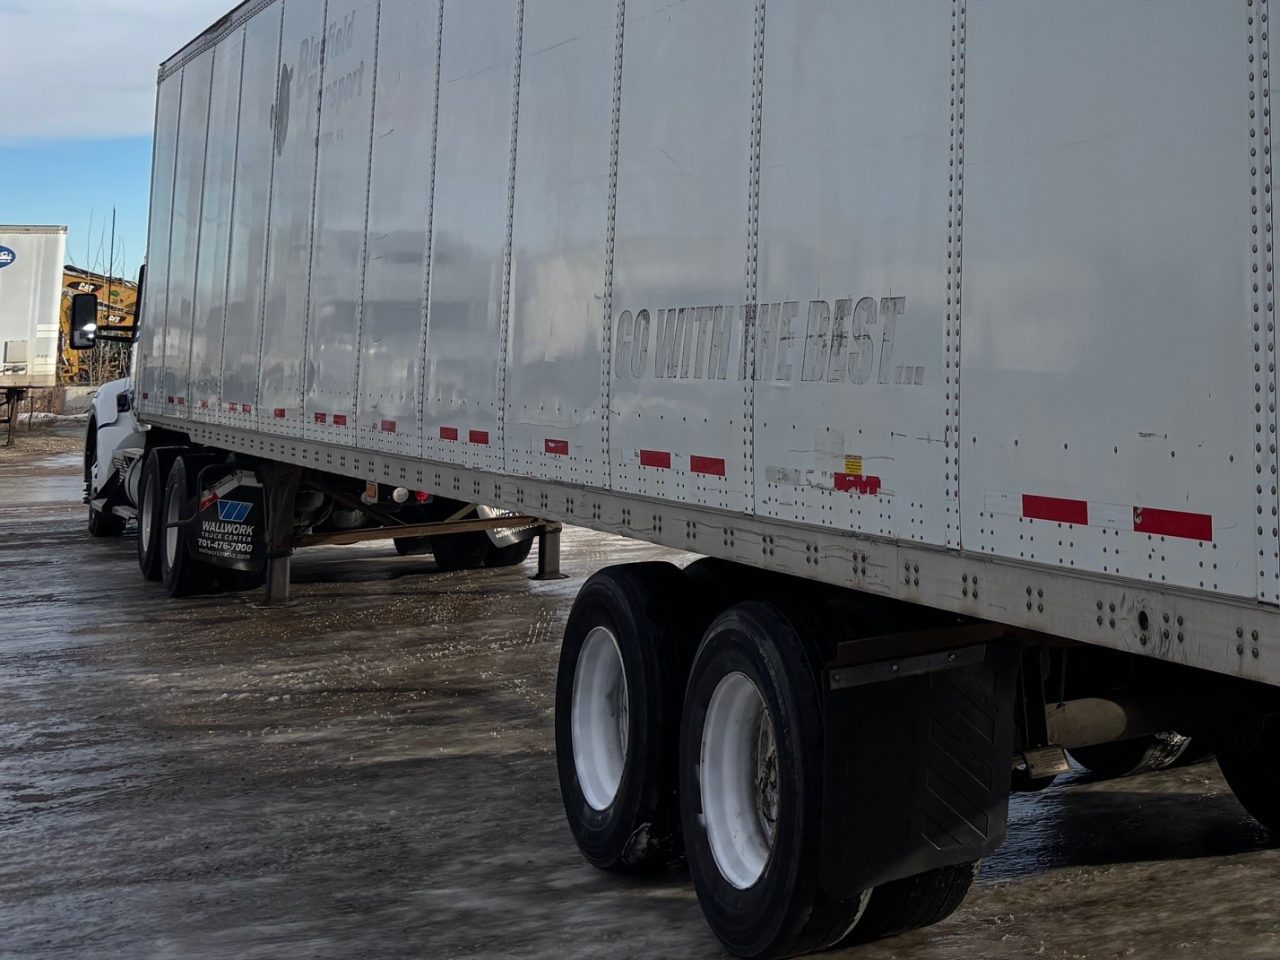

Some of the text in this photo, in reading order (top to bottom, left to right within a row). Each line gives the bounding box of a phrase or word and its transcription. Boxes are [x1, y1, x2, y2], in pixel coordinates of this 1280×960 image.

[78, 282, 95, 293] CAT
[614, 308, 651, 379] GO
[654, 304, 734, 379] WITH
[737, 301, 799, 381] THE
[202, 520, 255, 536] WALLWORK
[201, 532, 252, 542] TRUCK CENTER
[197, 538, 253, 552] 701-476-7000
